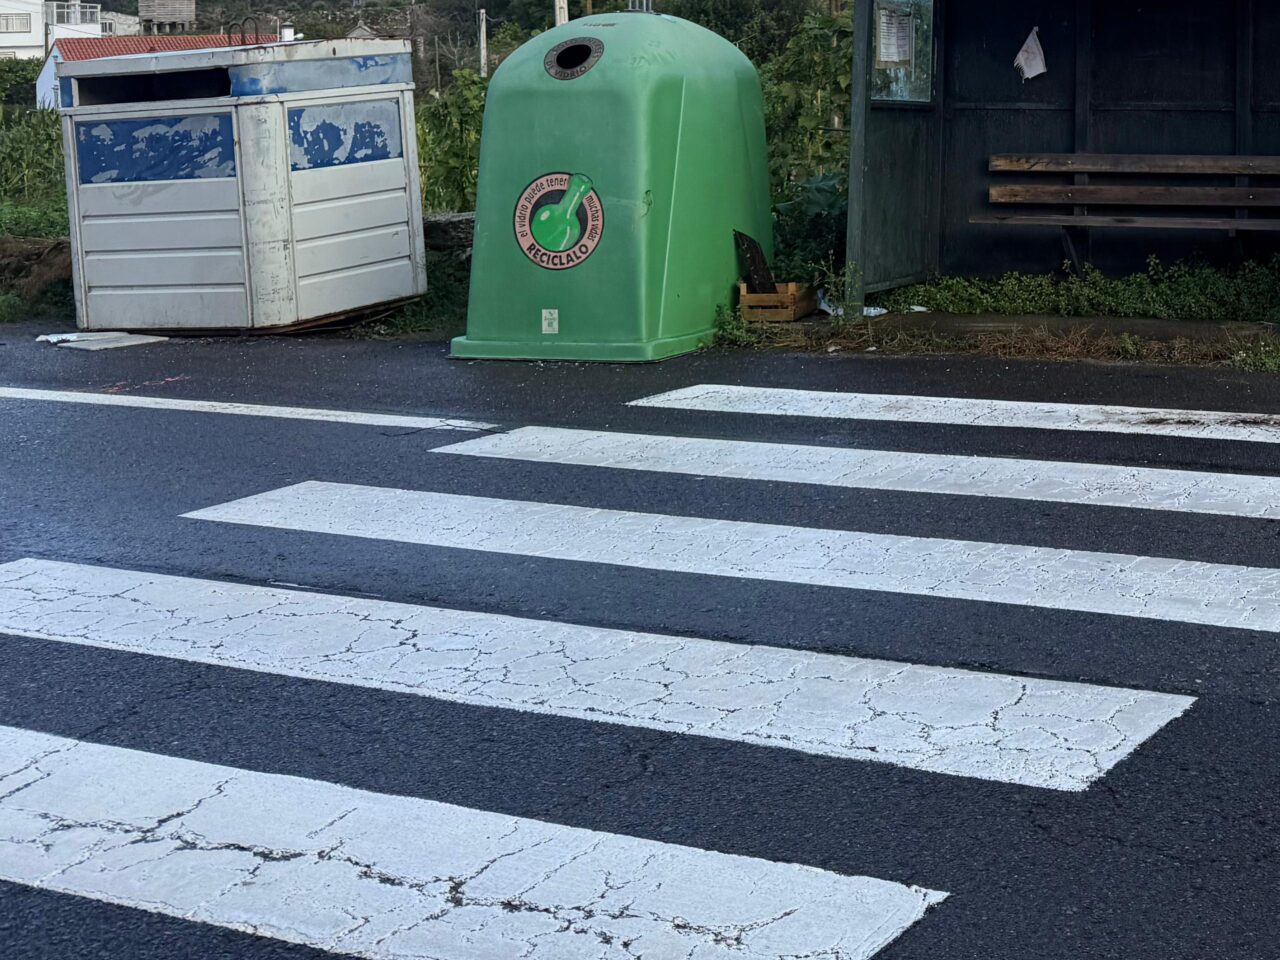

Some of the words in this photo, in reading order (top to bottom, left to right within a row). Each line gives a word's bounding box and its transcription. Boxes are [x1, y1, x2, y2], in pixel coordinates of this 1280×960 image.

[554, 65, 587, 78] VIDRIO
[524, 182, 545, 206] puede
[546, 177, 567, 188] tener
[516, 204, 529, 228] vidrio
[585, 195, 601, 222] muchas
[587, 223, 600, 242] vidas
[526, 242, 589, 266] RECICLALO
